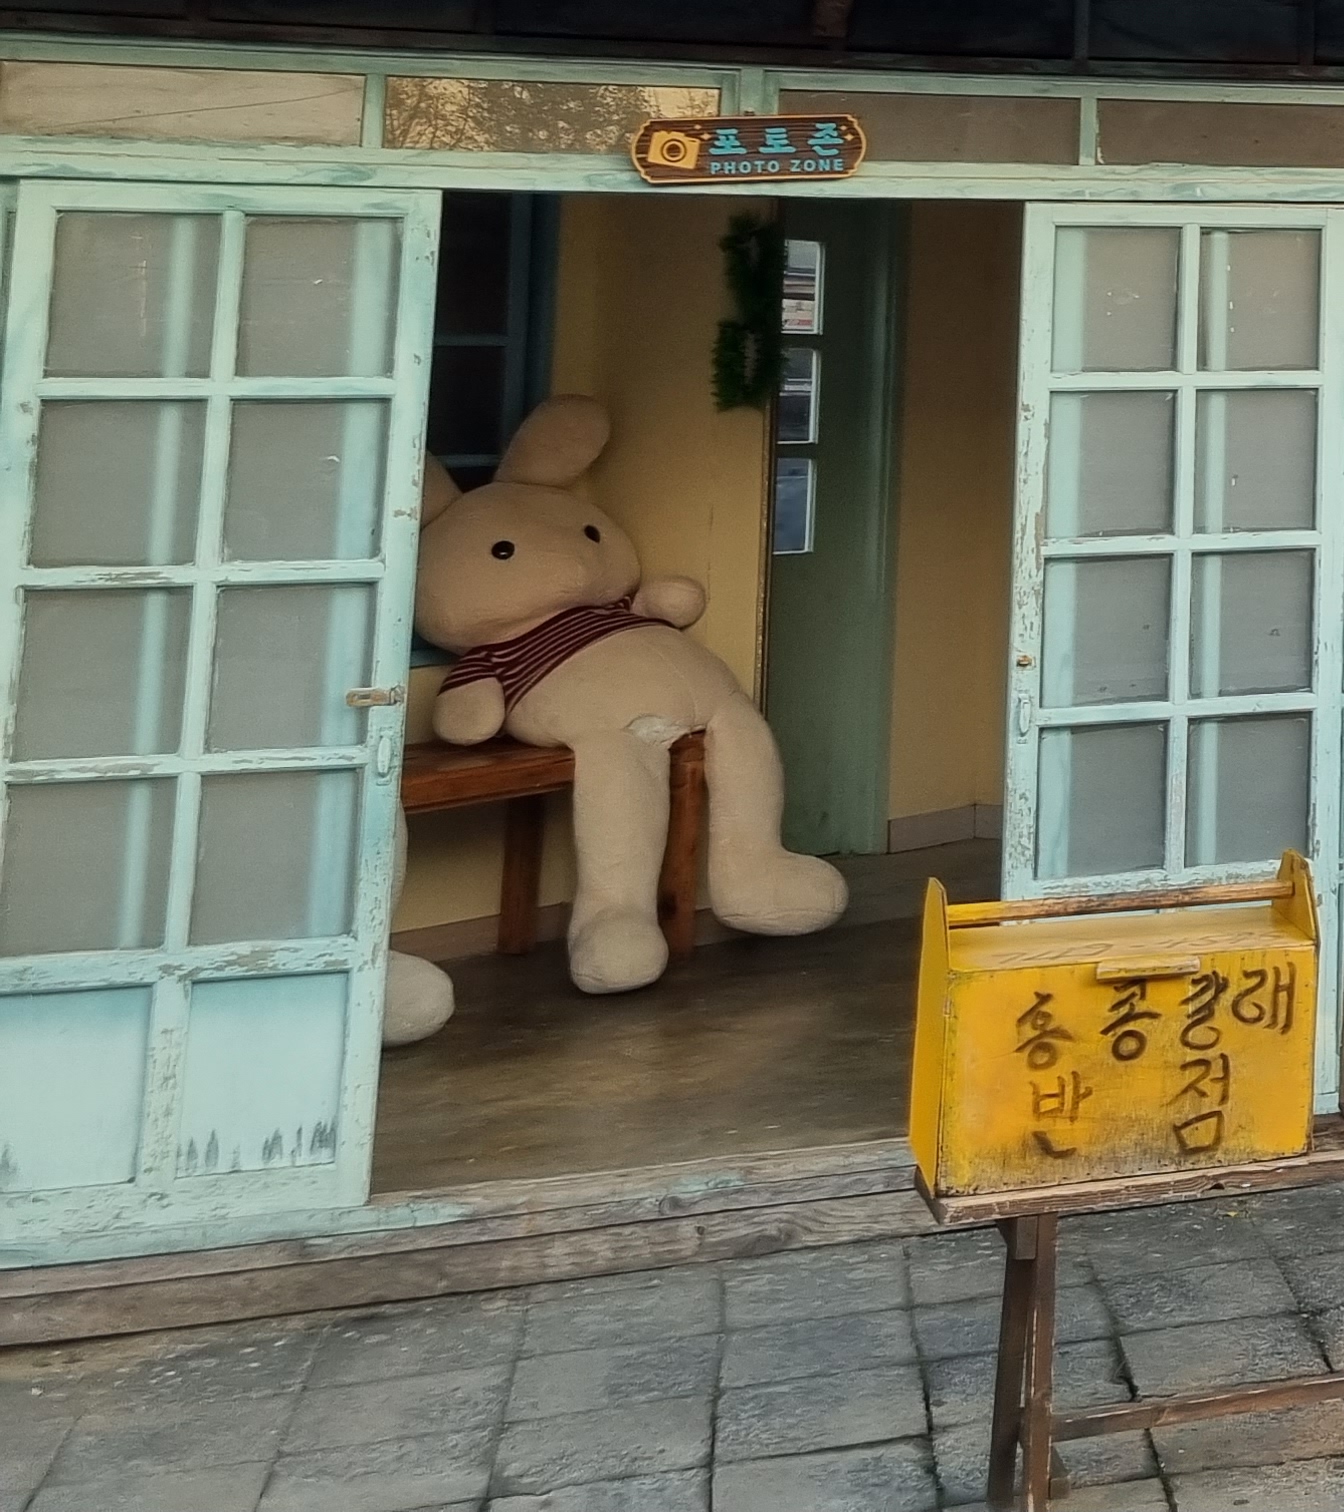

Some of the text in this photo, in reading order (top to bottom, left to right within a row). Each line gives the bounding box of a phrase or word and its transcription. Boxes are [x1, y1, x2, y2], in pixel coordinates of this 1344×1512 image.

[709, 122, 844, 156] 포토존
[710, 158, 844, 175] PHOTO ZONE
